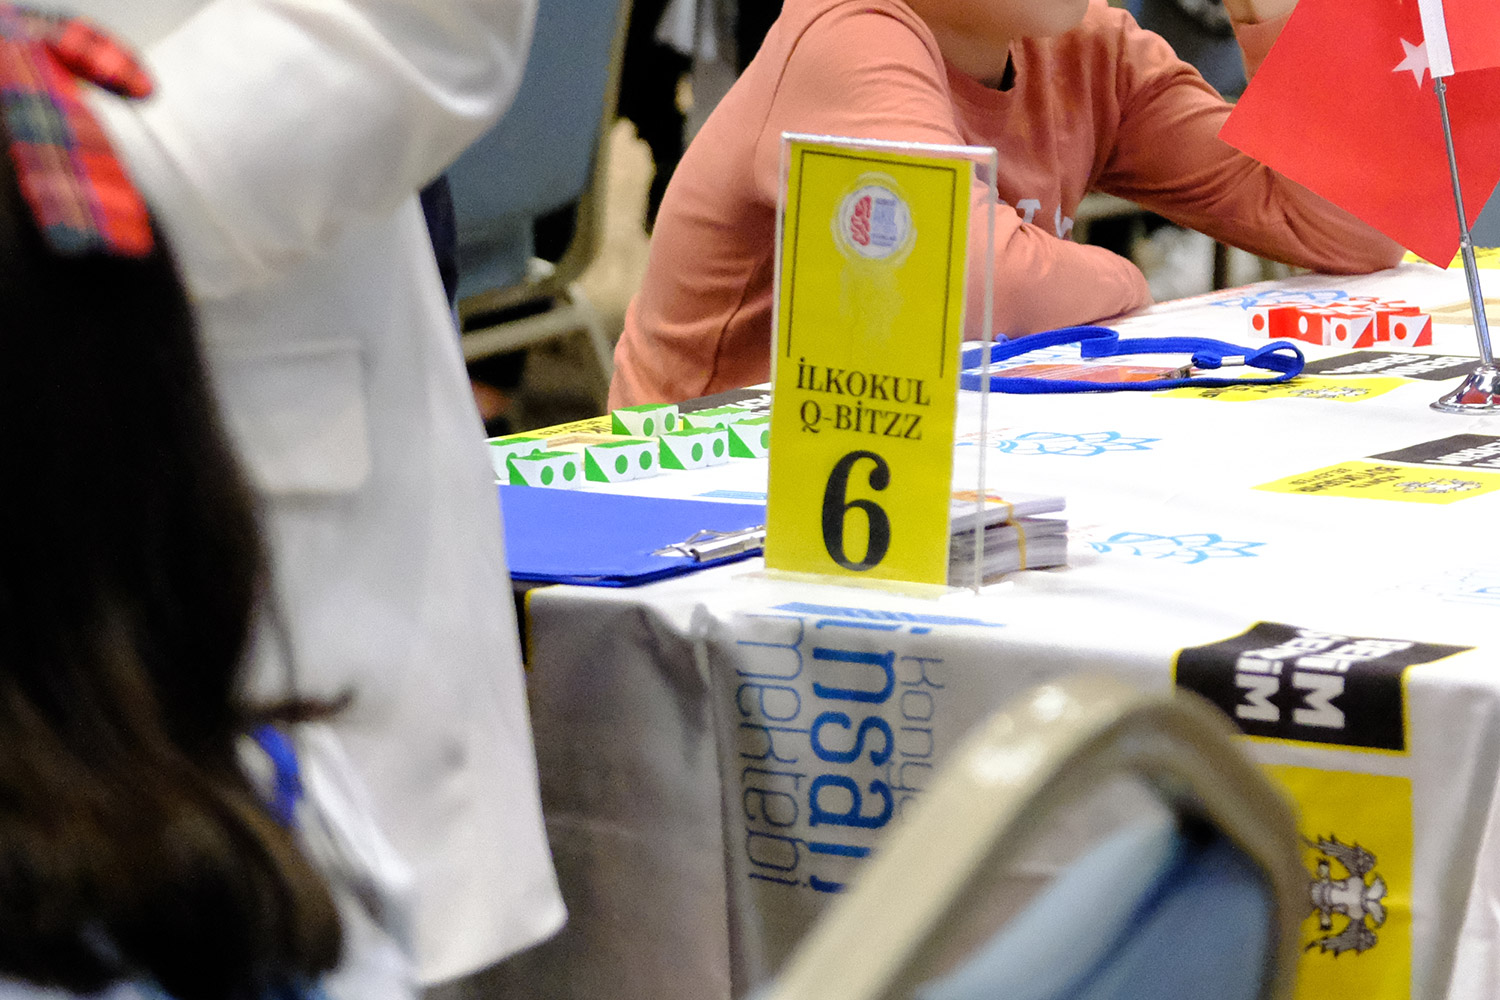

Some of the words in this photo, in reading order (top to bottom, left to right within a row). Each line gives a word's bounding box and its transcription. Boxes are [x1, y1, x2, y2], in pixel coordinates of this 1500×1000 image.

[796, 357, 931, 406] İLKOKUL
[800, 400, 923, 440] Q-BİTZZ
[821, 450, 891, 572] 6
[884, 654, 947, 806] kony
